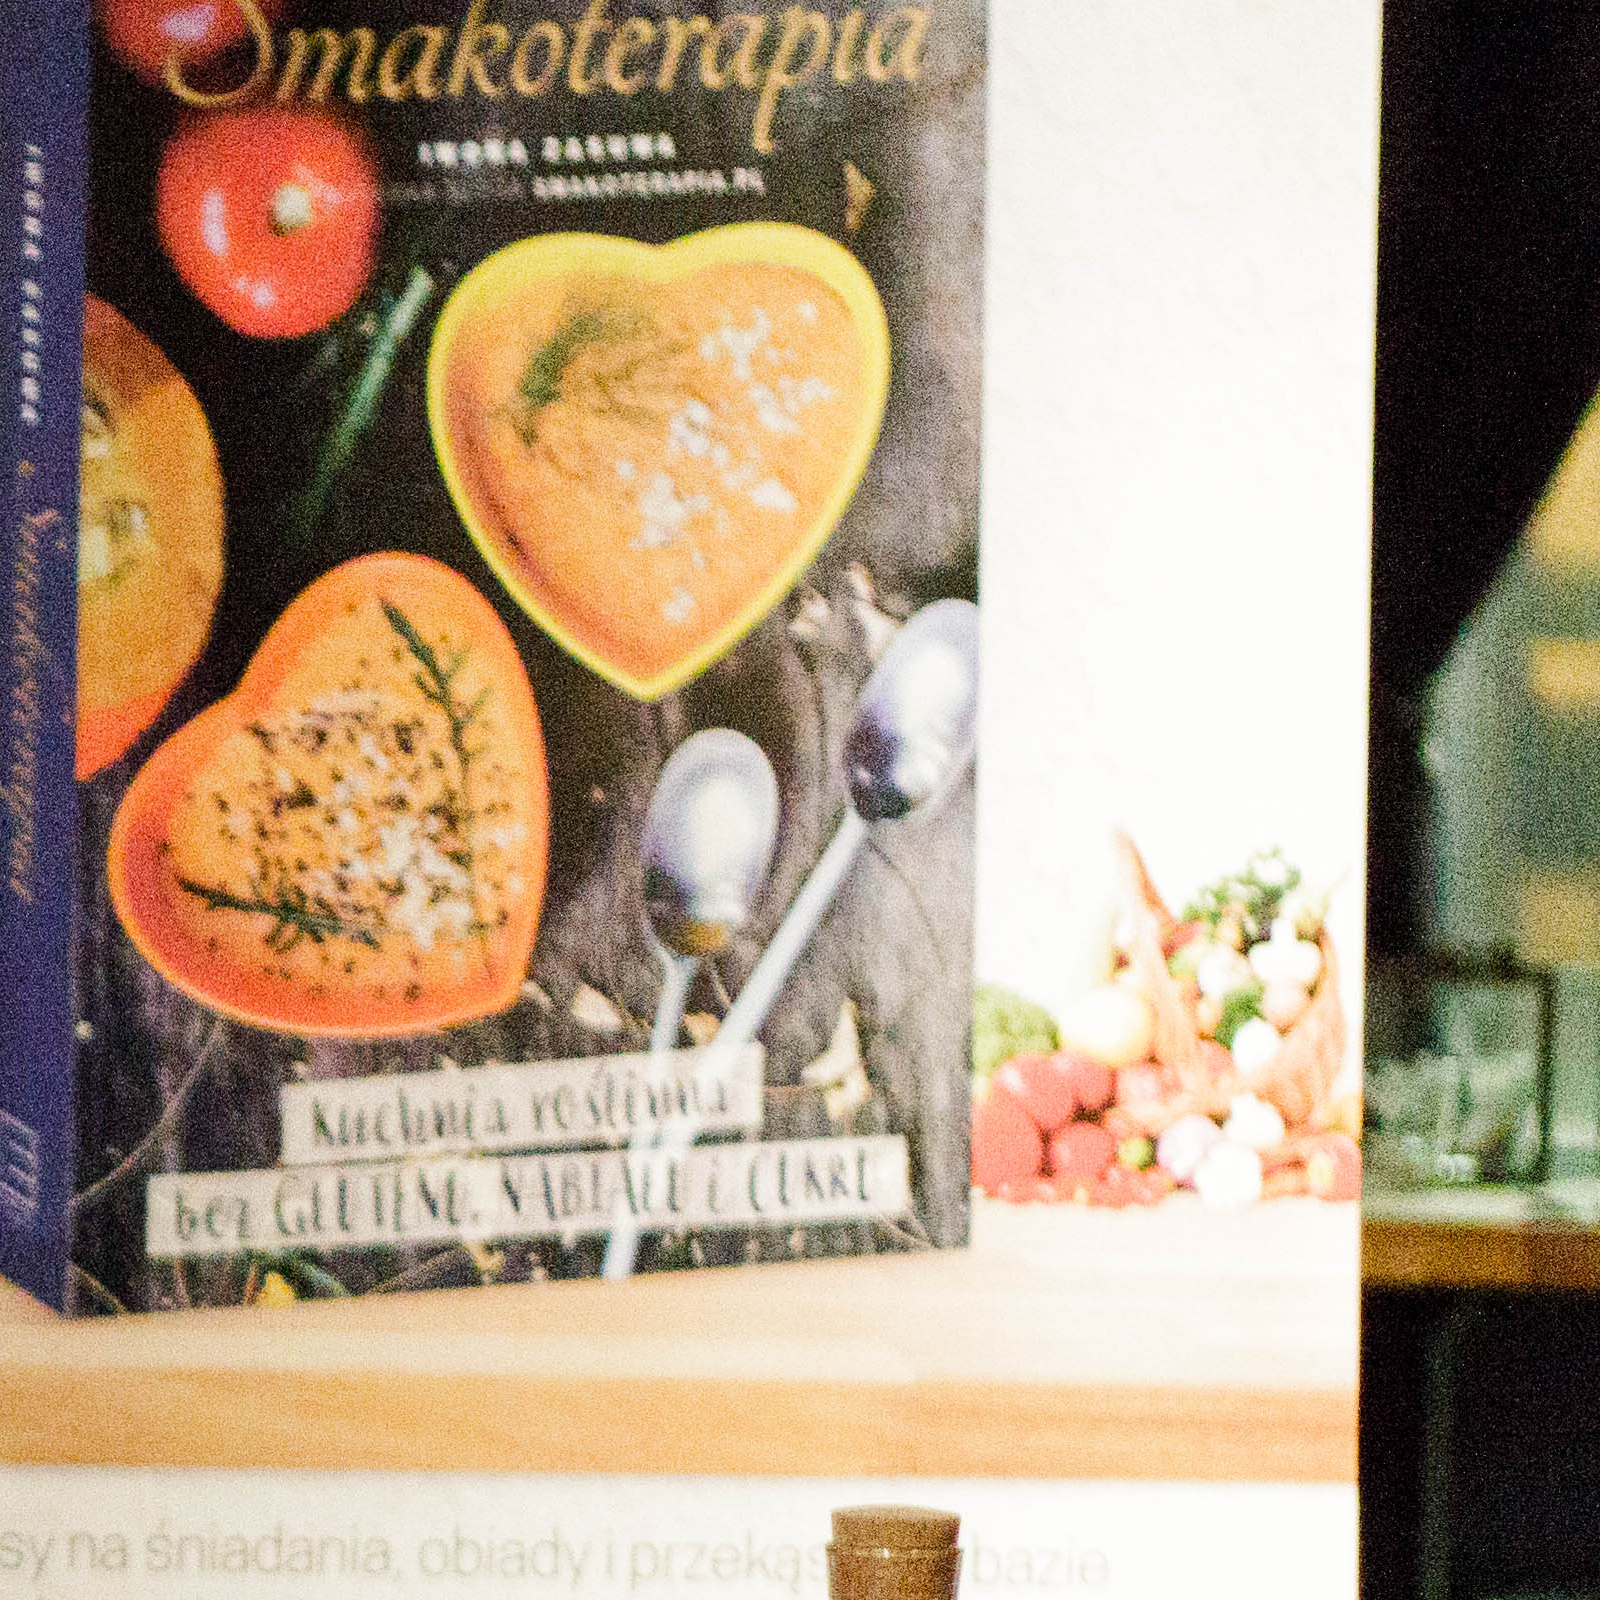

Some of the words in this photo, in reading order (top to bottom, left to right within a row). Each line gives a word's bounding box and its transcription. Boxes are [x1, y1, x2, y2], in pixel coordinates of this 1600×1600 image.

[163, 0, 927, 152] Smakoterapia
[310, 1082, 507, 1150] Kuchnia
[173, 1191, 251, 1242] bez
[67, 1528, 130, 1572] na
[144, 1519, 402, 1583] śniadania,
[417, 1523, 592, 1592] obiady
[603, 1529, 616, 1580] i
[969, 1532, 1110, 1591] bazie
